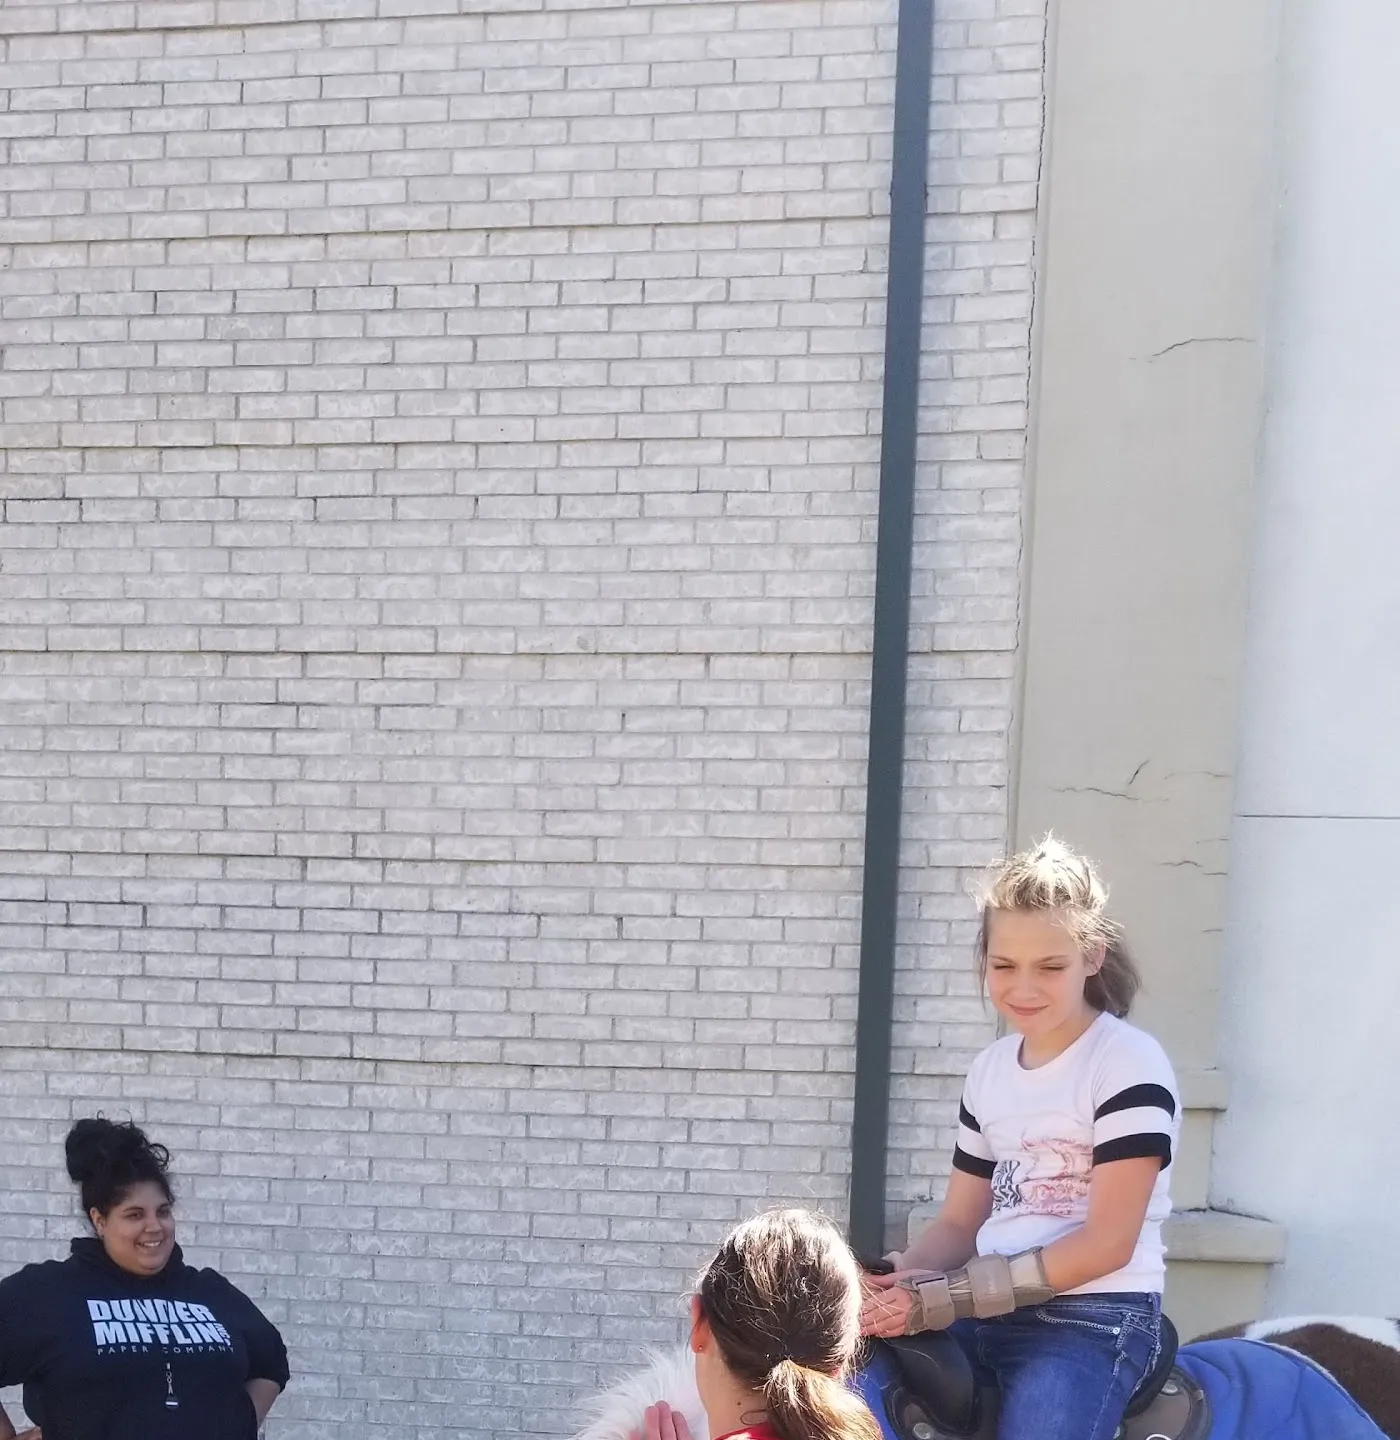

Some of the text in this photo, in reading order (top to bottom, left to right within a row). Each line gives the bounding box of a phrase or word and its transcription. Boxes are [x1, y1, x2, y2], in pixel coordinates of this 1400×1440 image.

[87, 1299, 216, 1323] DUNDER
[93, 1322, 225, 1345] MIFFLIN
[97, 1345, 149, 1356] PAPER
